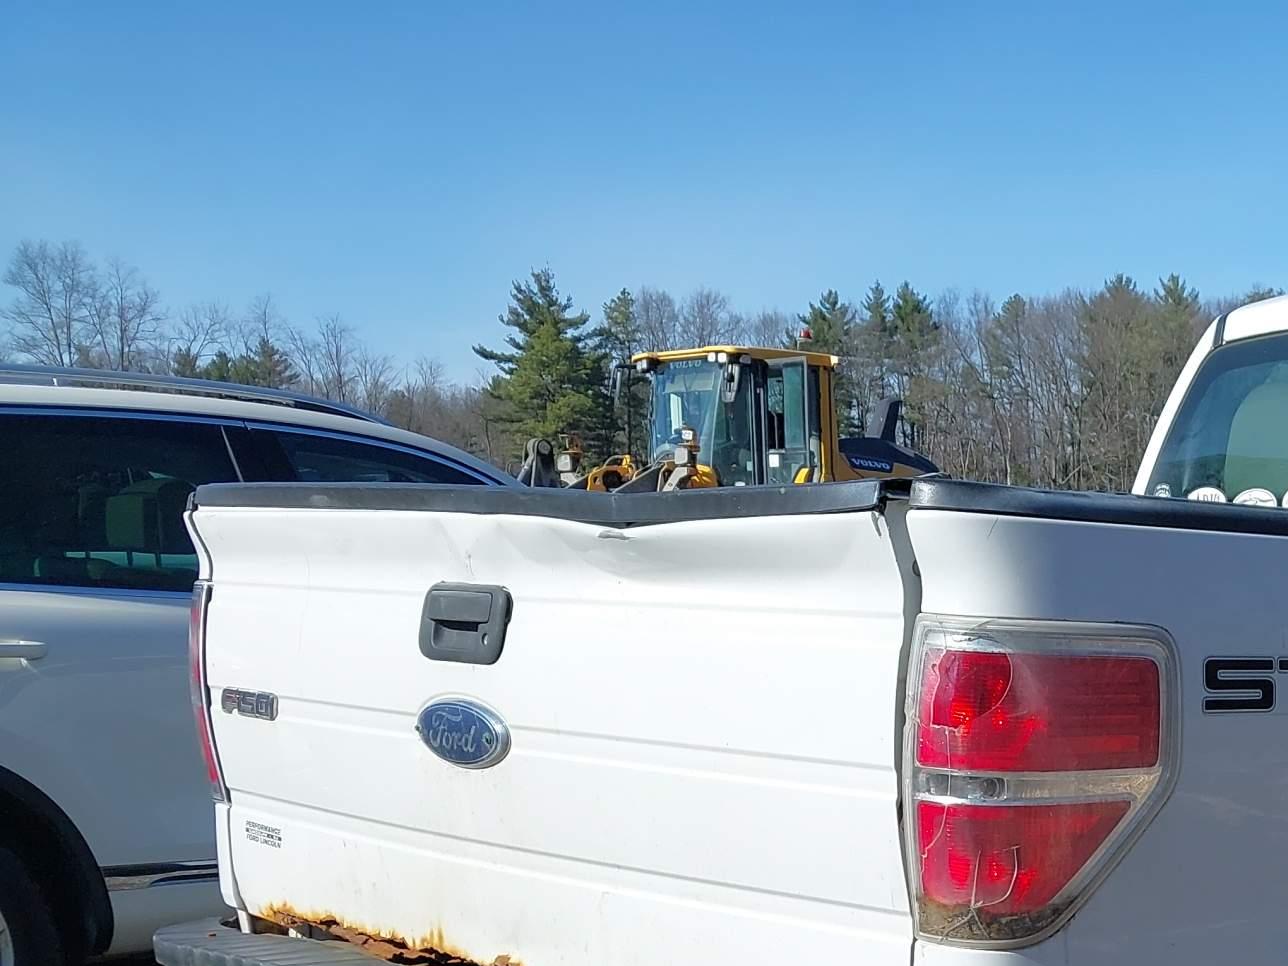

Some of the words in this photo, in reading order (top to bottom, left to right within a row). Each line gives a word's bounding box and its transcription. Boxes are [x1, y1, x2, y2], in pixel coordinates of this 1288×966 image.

[851, 457, 891, 470] VOLVO
[429, 710, 477, 753] Ford
[260, 837, 282, 849] LINCOLN
